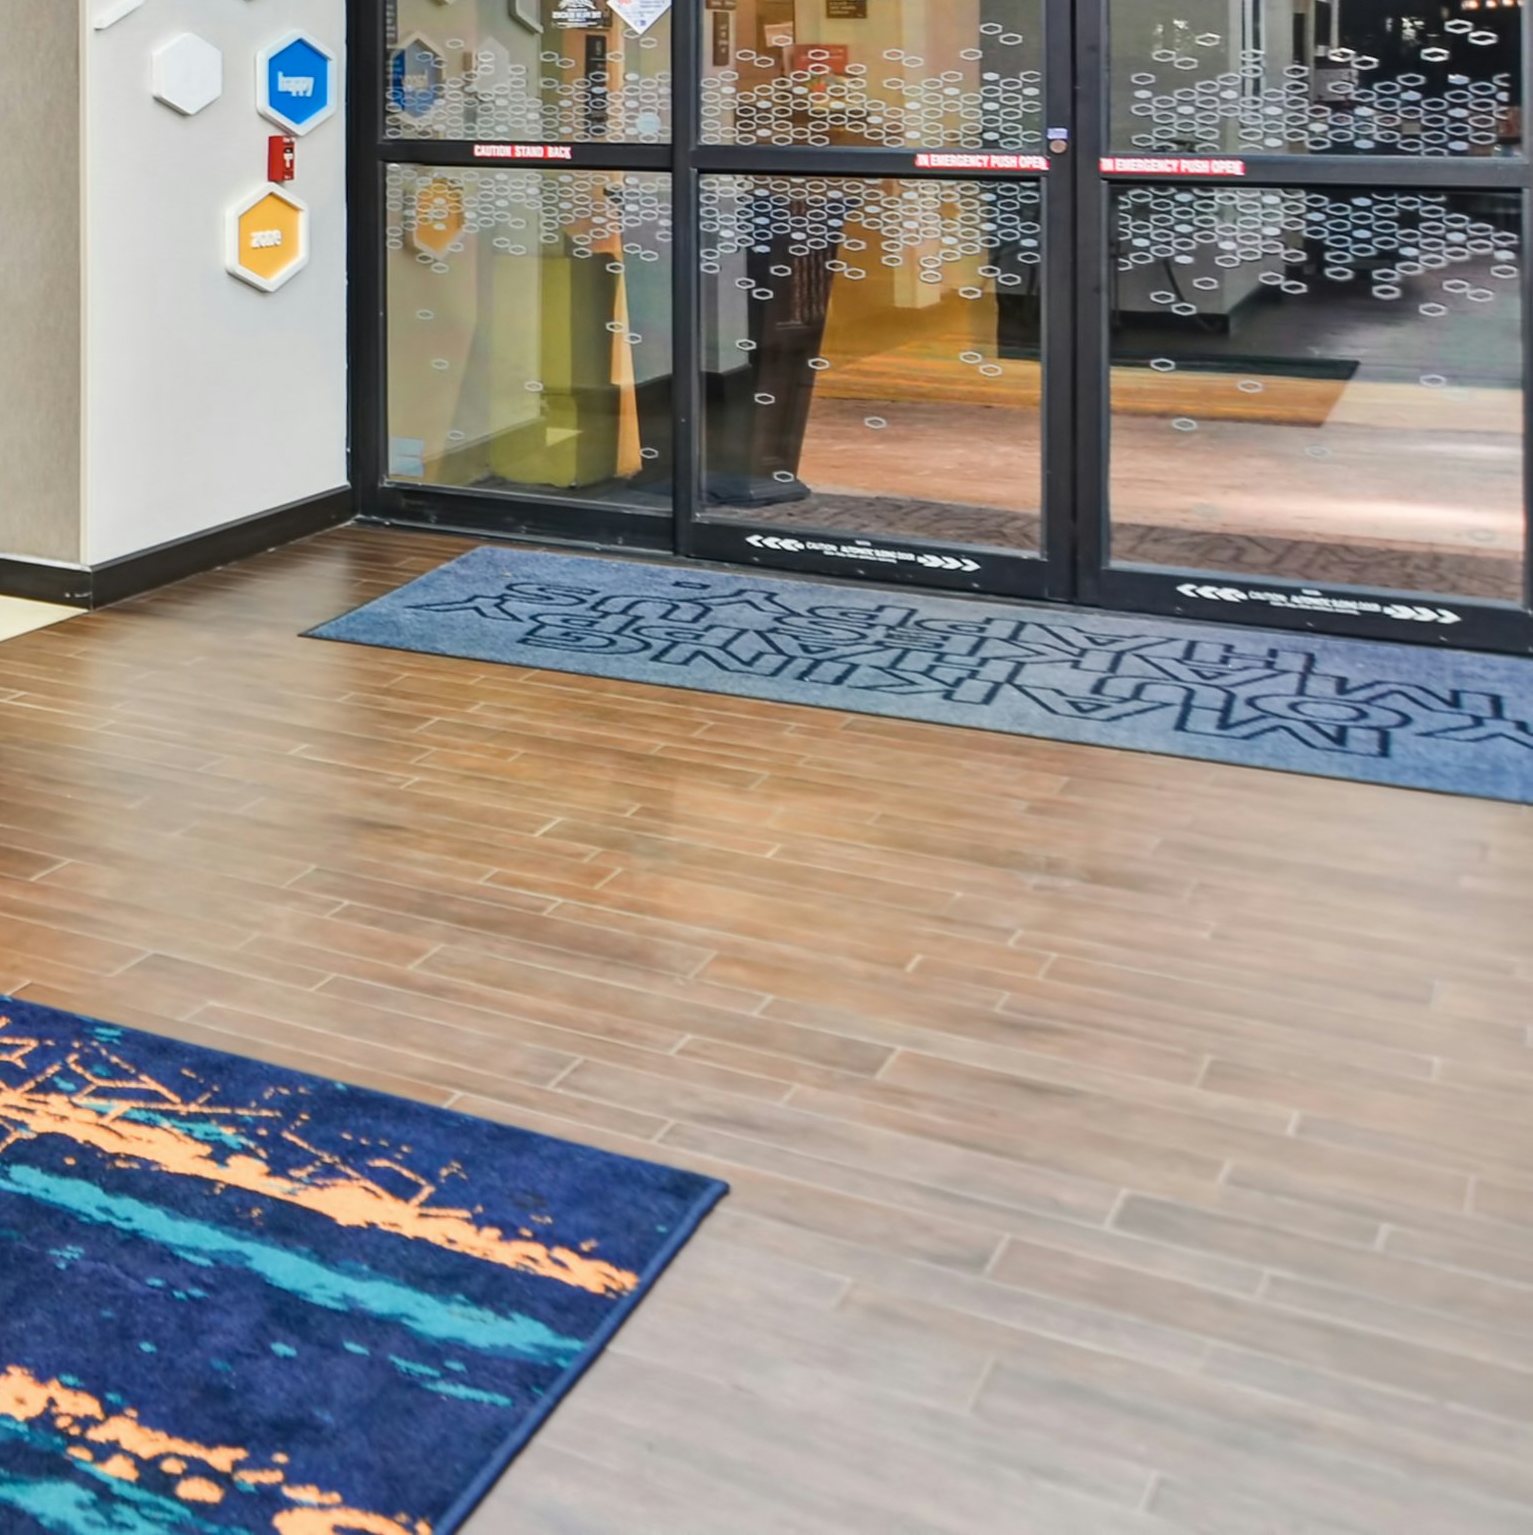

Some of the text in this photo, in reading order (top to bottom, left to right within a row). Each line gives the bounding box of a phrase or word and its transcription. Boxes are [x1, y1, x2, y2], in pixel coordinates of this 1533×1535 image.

[514, 145, 545, 158] STAND
[546, 146, 572, 159] BACK
[930, 153, 991, 169] EMERGENCY
[991, 154, 1019, 169] PUSH
[1115, 157, 1181, 174] EMERGENCY
[1181, 158, 1211, 175] PUSH
